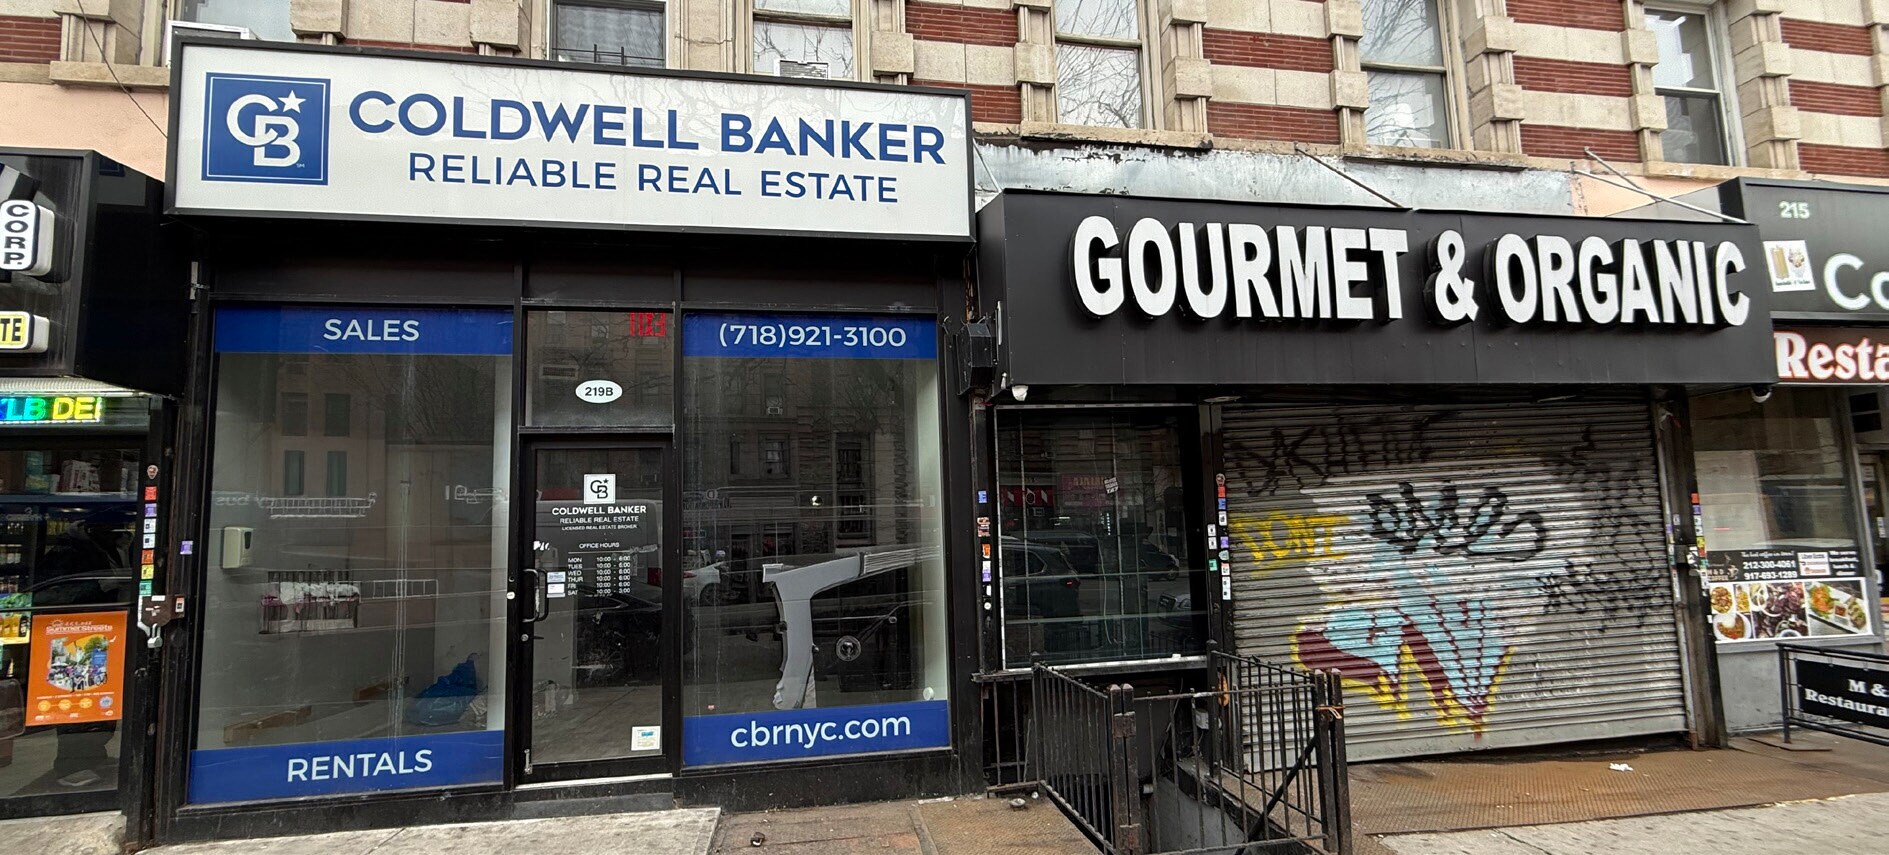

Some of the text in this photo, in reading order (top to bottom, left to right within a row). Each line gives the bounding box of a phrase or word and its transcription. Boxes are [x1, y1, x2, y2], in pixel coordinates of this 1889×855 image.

[226, 93, 301, 168] CB
[349, 90, 946, 165] COLDWELL BANKER
[409, 152, 898, 204] RELIABLE REAL ESTATE
[1779, 200, 1810, 218] 215
[4, 204, 30, 265] CORP.
[1073, 215, 1750, 326] GOURMET & ORGANIC
[323, 318, 420, 342] SALES
[719, 323, 906, 348] (718)921-3100
[584, 386, 614, 397] 219B
[590, 480, 608, 499] CB
[552, 505, 646, 516] COLDWELL BANKER
[1804, 688, 1889, 716] Restaura
[1848, 679, 1889, 698] M &
[730, 716, 912, 749] cbrnyc.com
[286, 748, 433, 782] RENTALS
